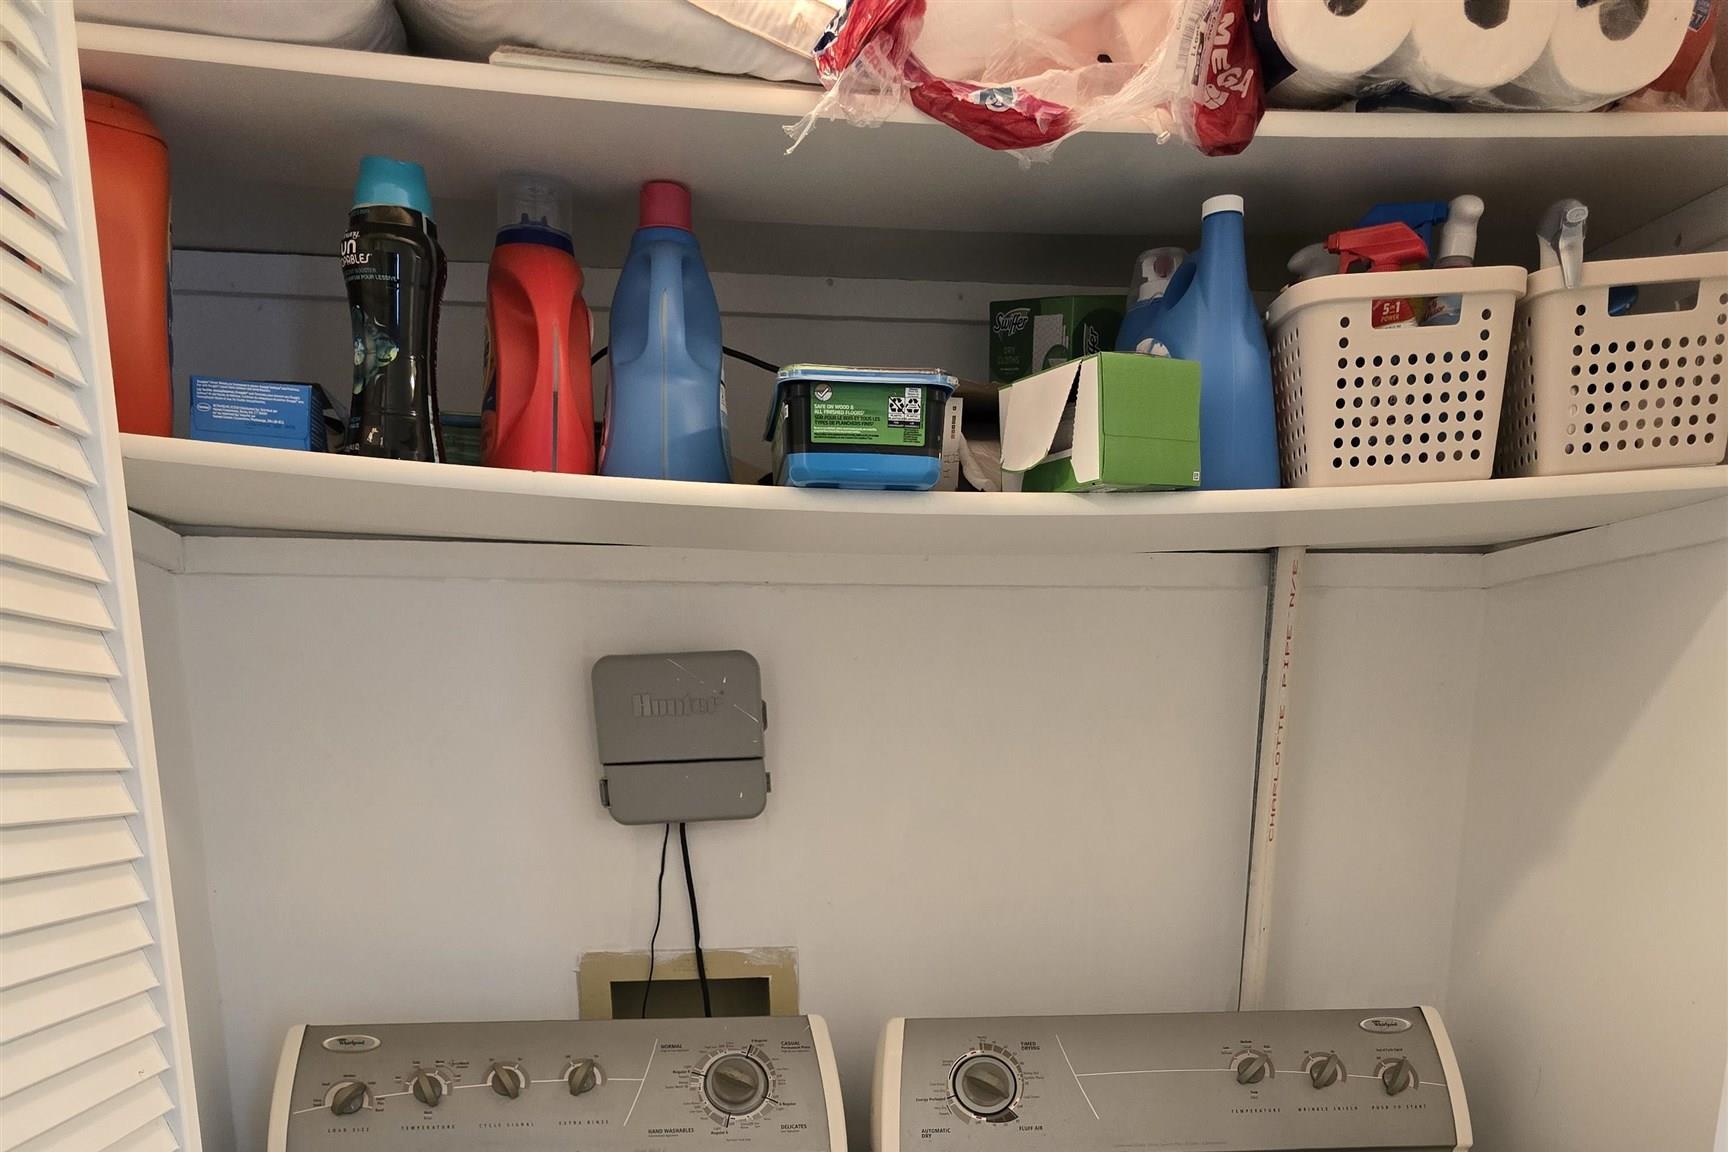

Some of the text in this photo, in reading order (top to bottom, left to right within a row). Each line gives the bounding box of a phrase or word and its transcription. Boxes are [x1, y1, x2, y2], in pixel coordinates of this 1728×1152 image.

[1212, 12, 1254, 98] MEGA
[992, 310, 1030, 337] Swiffer
[1382, 302, 1391, 316] 5
[1268, 704, 1286, 842] CHARLOTTE
[1281, 625, 1293, 688] PIPE
